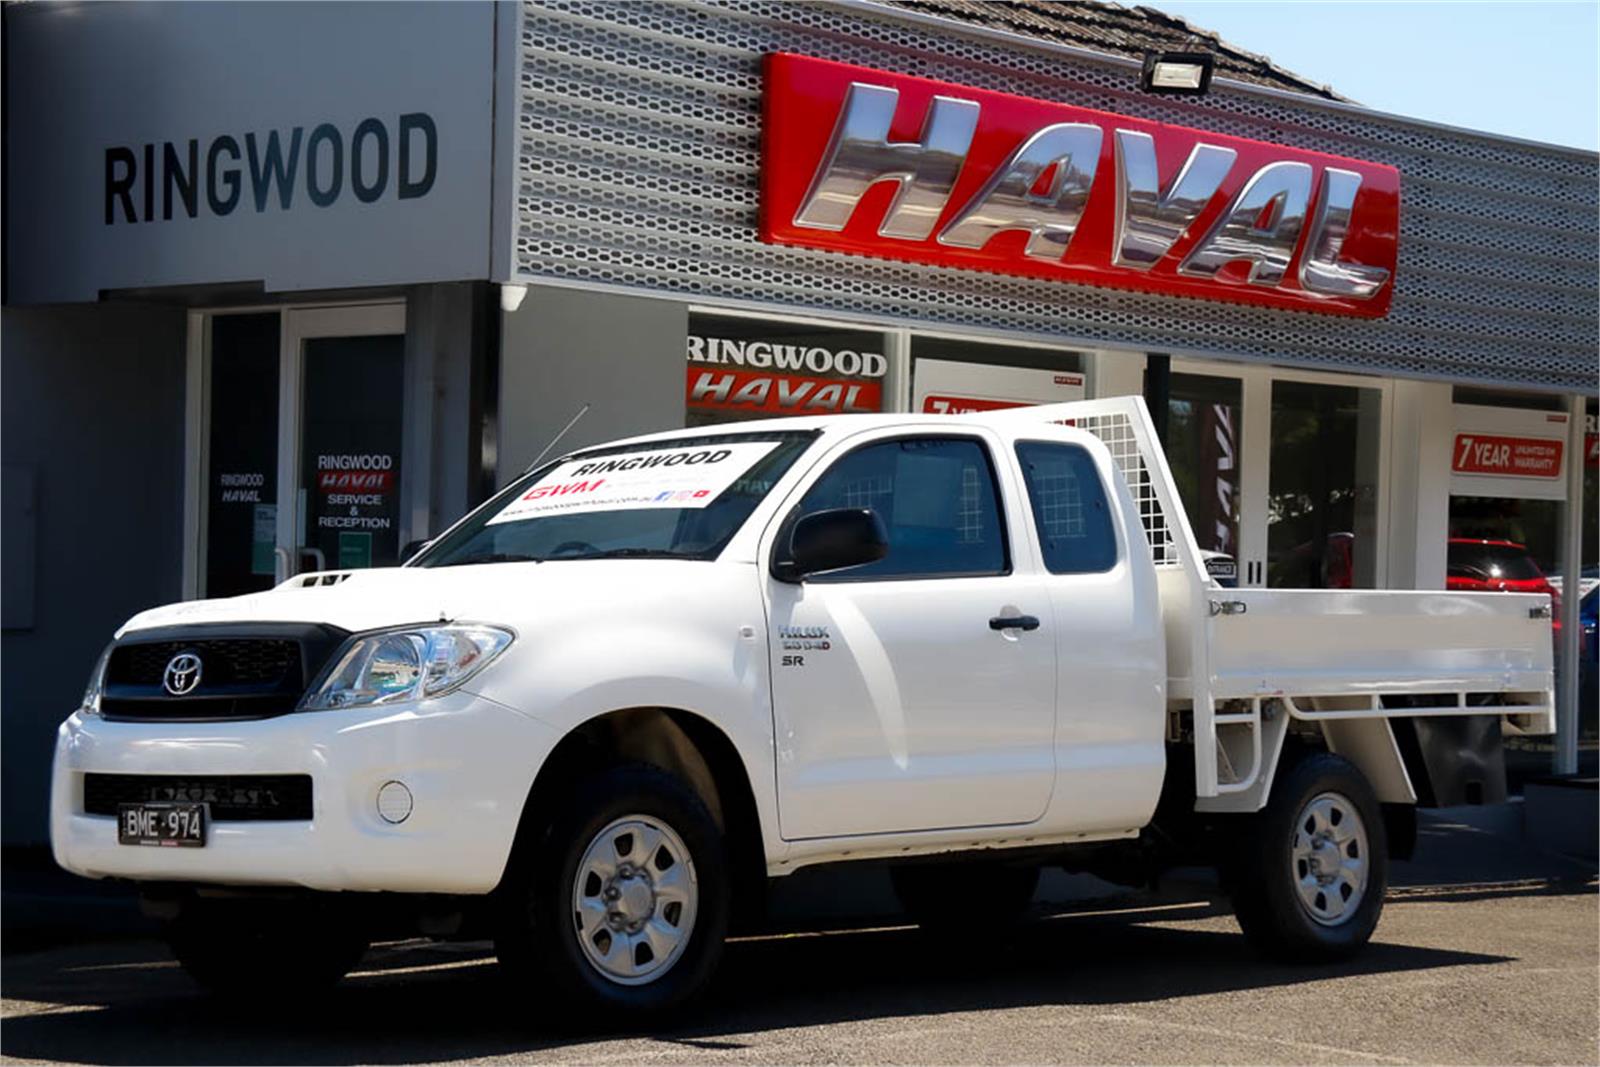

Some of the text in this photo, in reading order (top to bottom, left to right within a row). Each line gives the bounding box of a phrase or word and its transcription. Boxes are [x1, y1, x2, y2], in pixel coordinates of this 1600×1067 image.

[104, 112, 438, 226] RINGWOOD
[793, 80, 1392, 299] HAVAL
[686, 335, 888, 378] RINGWOOD
[691, 372, 881, 412] HAVAL
[1458, 438, 1511, 468] 7 YEAR
[318, 455, 392, 470] RINGWOOD
[571, 449, 732, 477] RINGWOOD
[221, 473, 264, 486] RINGWOOD
[321, 474, 384, 488] HAVAL
[222, 490, 261, 502] HAVAL
[523, 479, 606, 501] GWM
[327, 494, 382, 505] SERVICE
[349, 505, 358, 516] &
[318, 517, 390, 529] RECEPTION
[782, 655, 804, 666] SR
